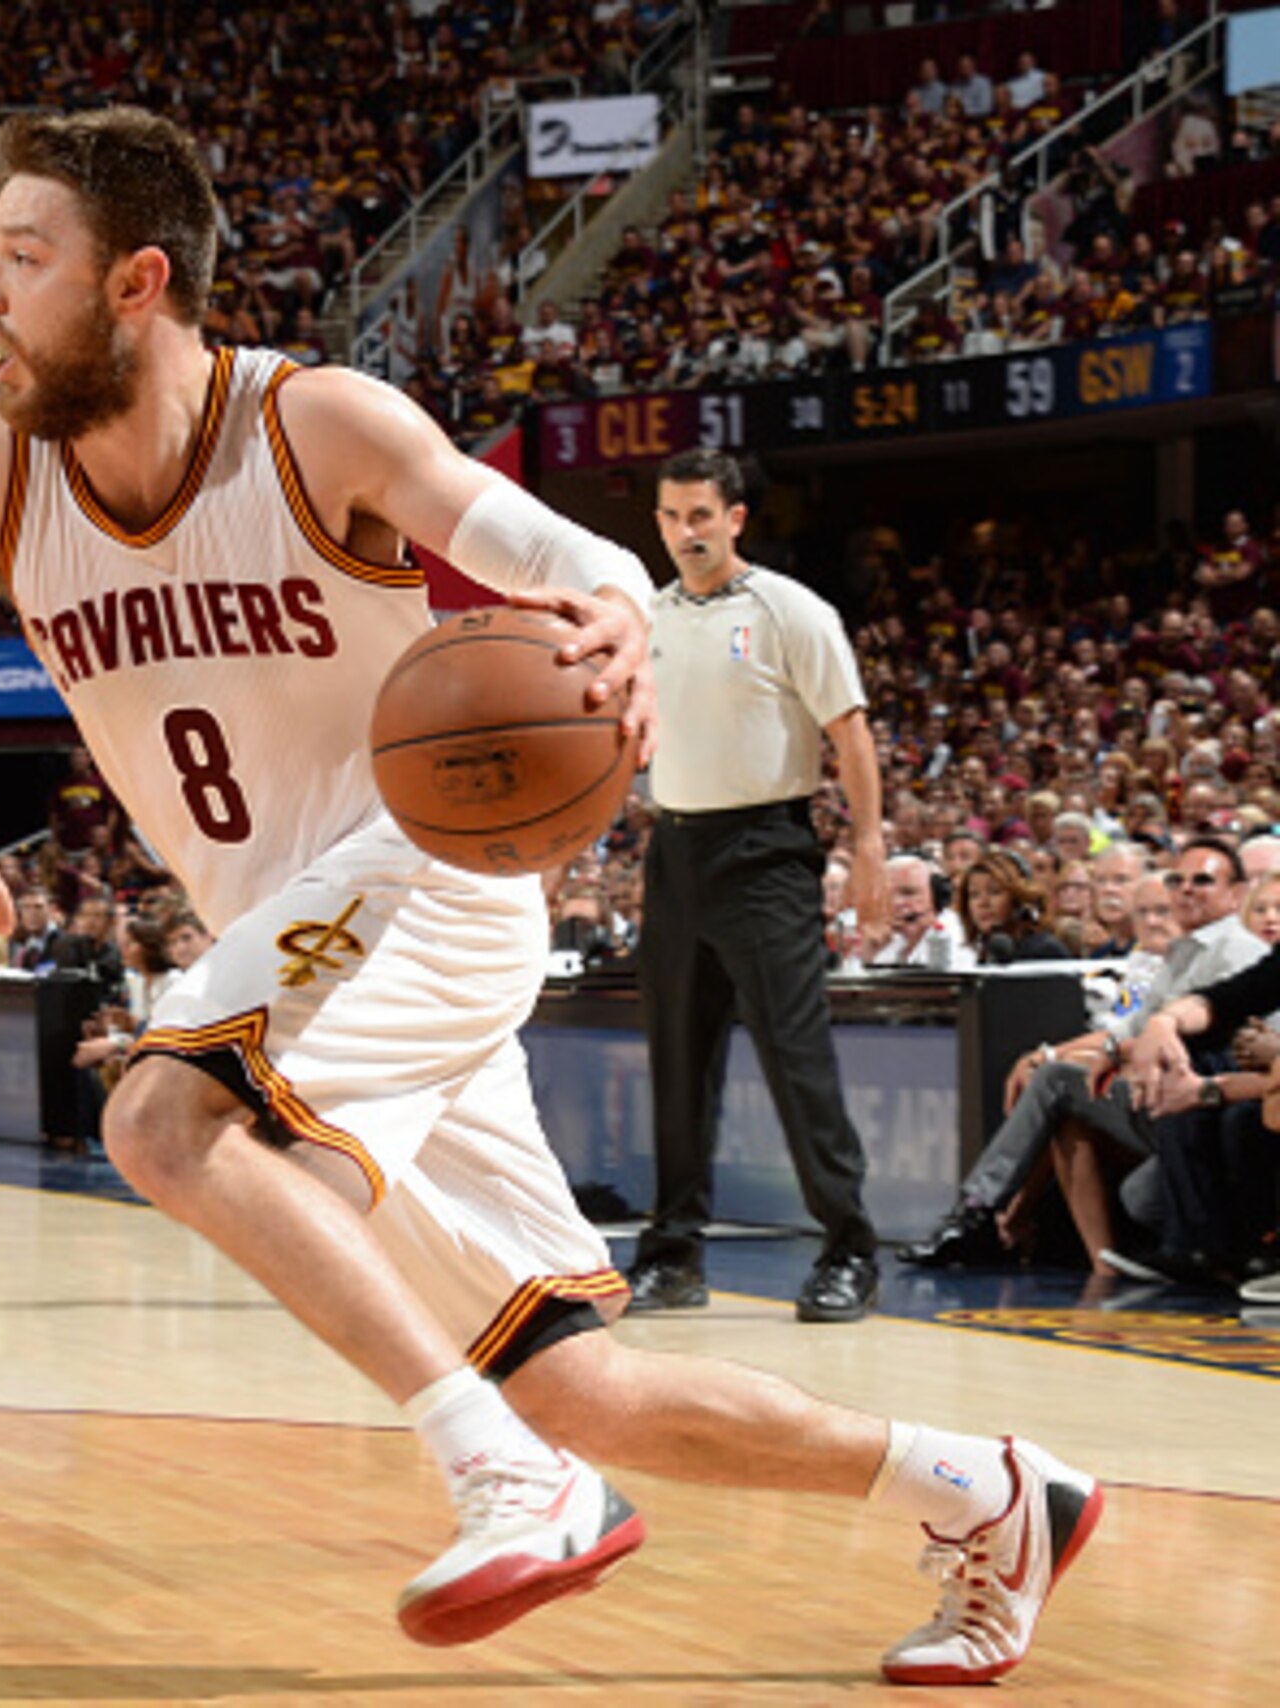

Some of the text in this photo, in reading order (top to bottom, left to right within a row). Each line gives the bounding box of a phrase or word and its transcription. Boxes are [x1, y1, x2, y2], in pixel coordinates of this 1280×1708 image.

[597, 396, 671, 459] CLE
[698, 394, 743, 448] 51
[1006, 357, 1055, 417] 59
[1078, 342, 1156, 404] GSW
[162, 707, 252, 844] 8
